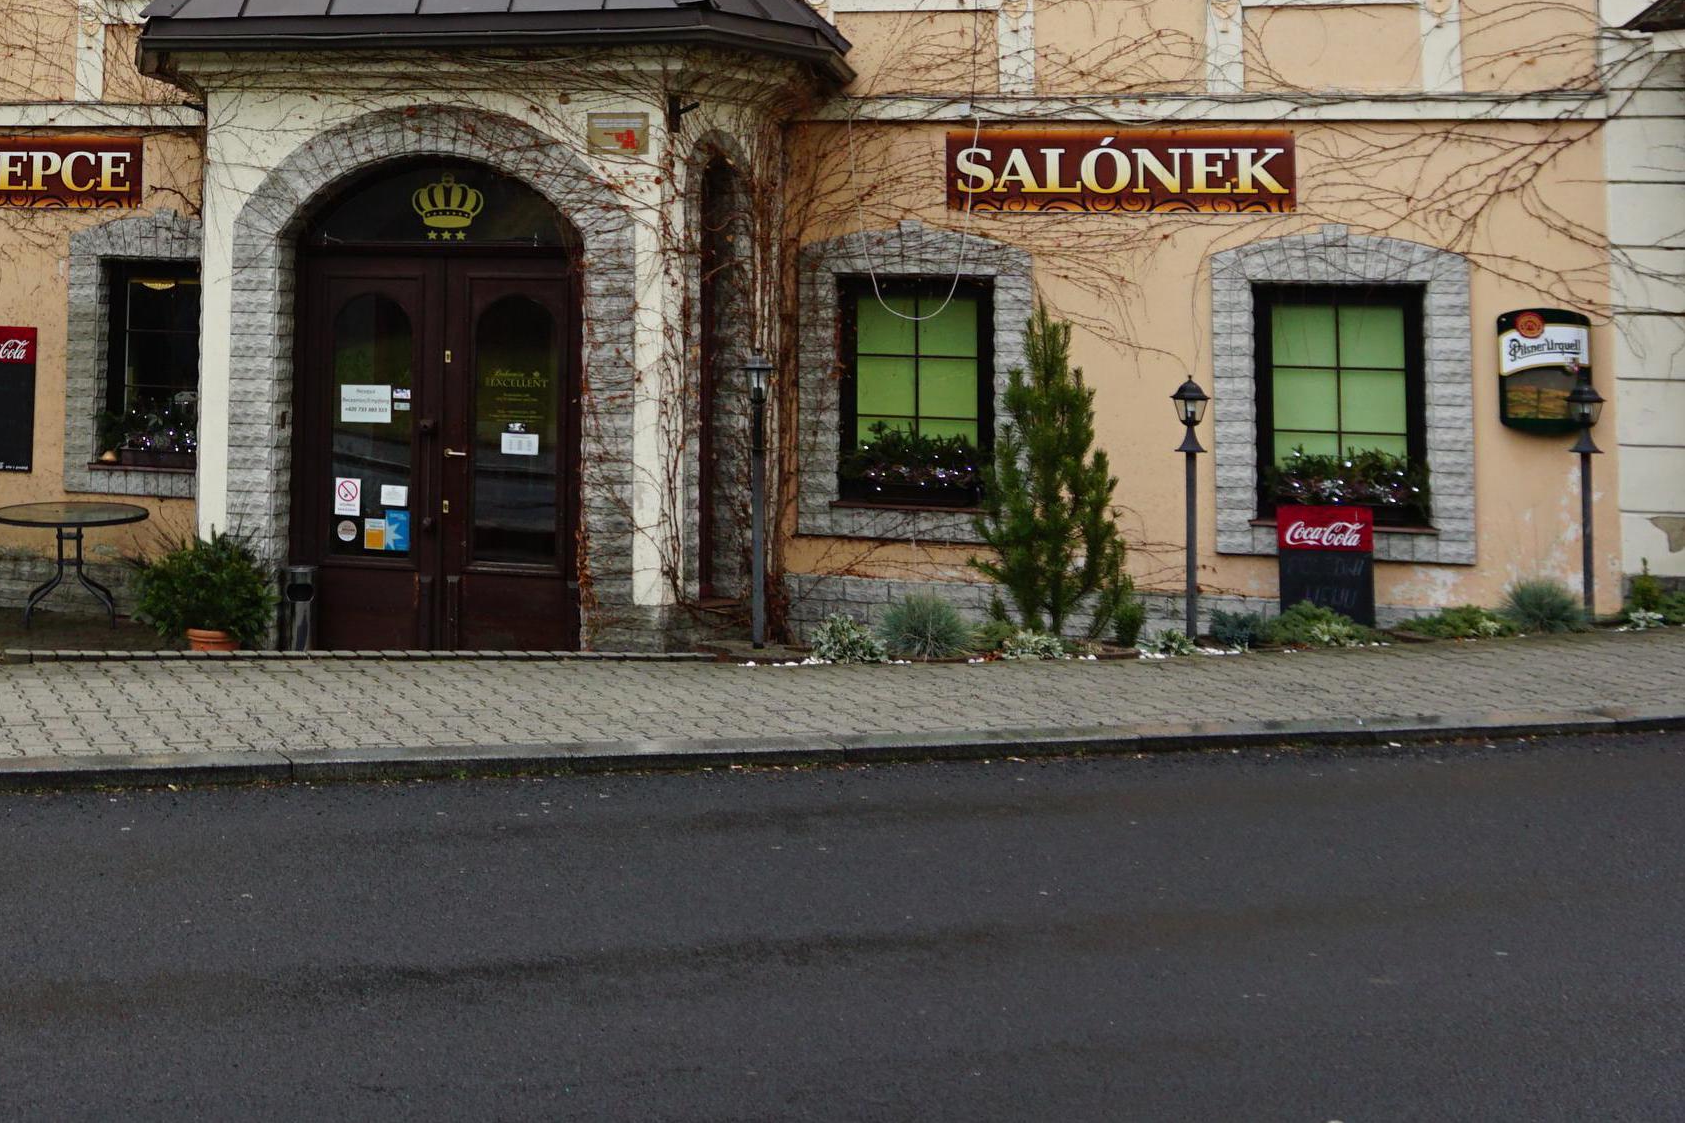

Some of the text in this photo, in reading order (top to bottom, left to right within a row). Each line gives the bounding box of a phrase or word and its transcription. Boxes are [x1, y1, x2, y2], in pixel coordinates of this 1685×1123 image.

[956, 137, 1290, 194] SALÓNEK
[1509, 338, 1581, 362] Pilsner Urquell
[490, 378, 549, 388] EXCELLENT
[1286, 521, 1365, 546] Coca-Cola
